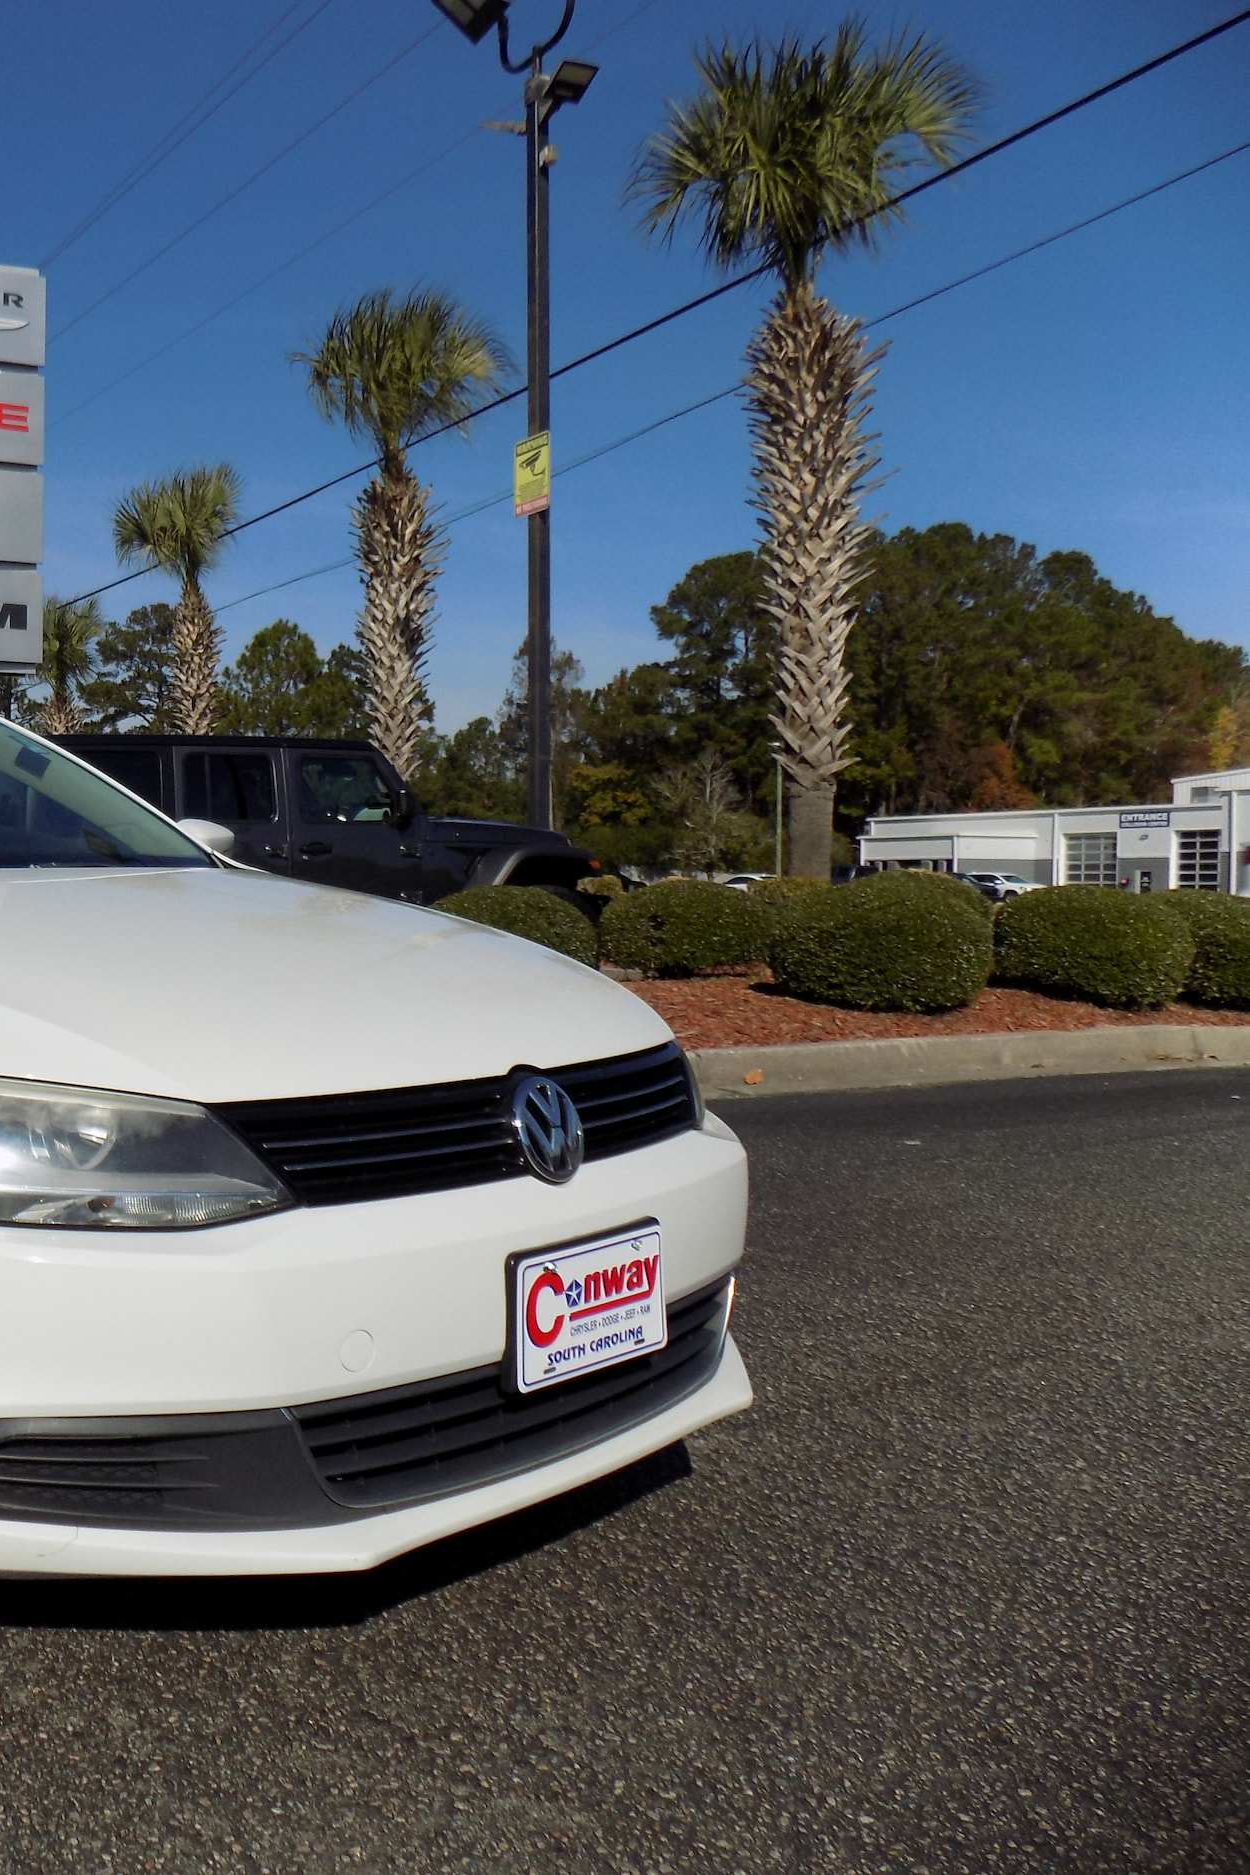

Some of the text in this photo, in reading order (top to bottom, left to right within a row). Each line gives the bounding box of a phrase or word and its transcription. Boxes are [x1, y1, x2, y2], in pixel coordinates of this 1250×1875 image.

[1121, 812, 1168, 822] ENTRANCE
[570, 1303, 651, 1337] CHRYSLER DODGE JEEP RAM
[547, 1325, 643, 1366] SOUTH CAROLINA
